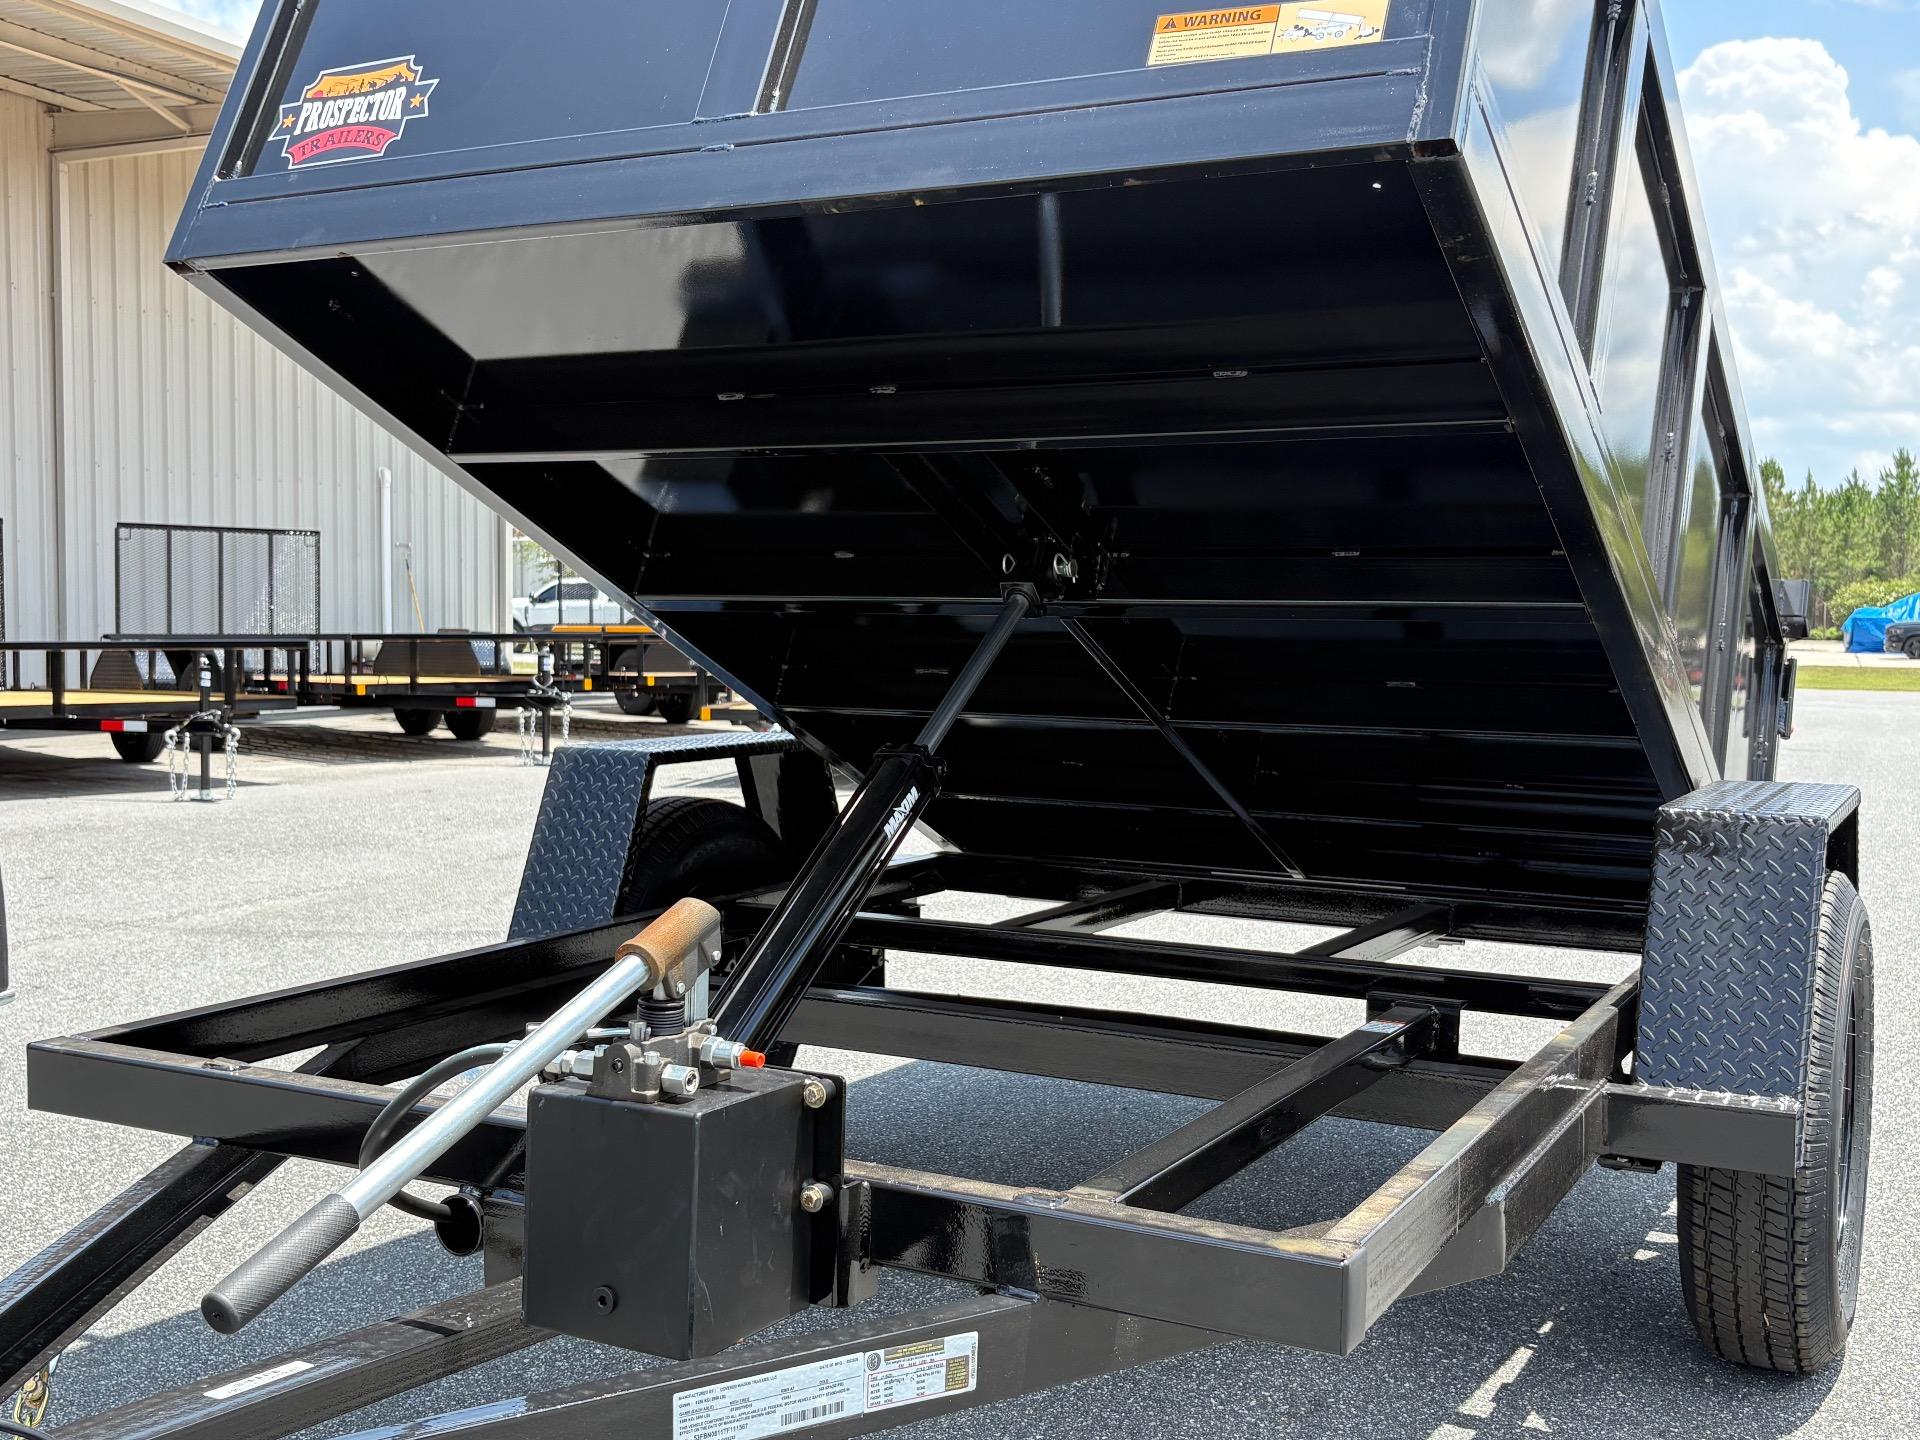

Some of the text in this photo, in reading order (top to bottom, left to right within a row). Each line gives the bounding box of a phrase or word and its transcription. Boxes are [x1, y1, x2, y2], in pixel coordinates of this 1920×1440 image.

[1183, 9, 1261, 27] WARNING
[294, 86, 407, 135] PROSPECTOR
[298, 128, 386, 156] TRAILERS
